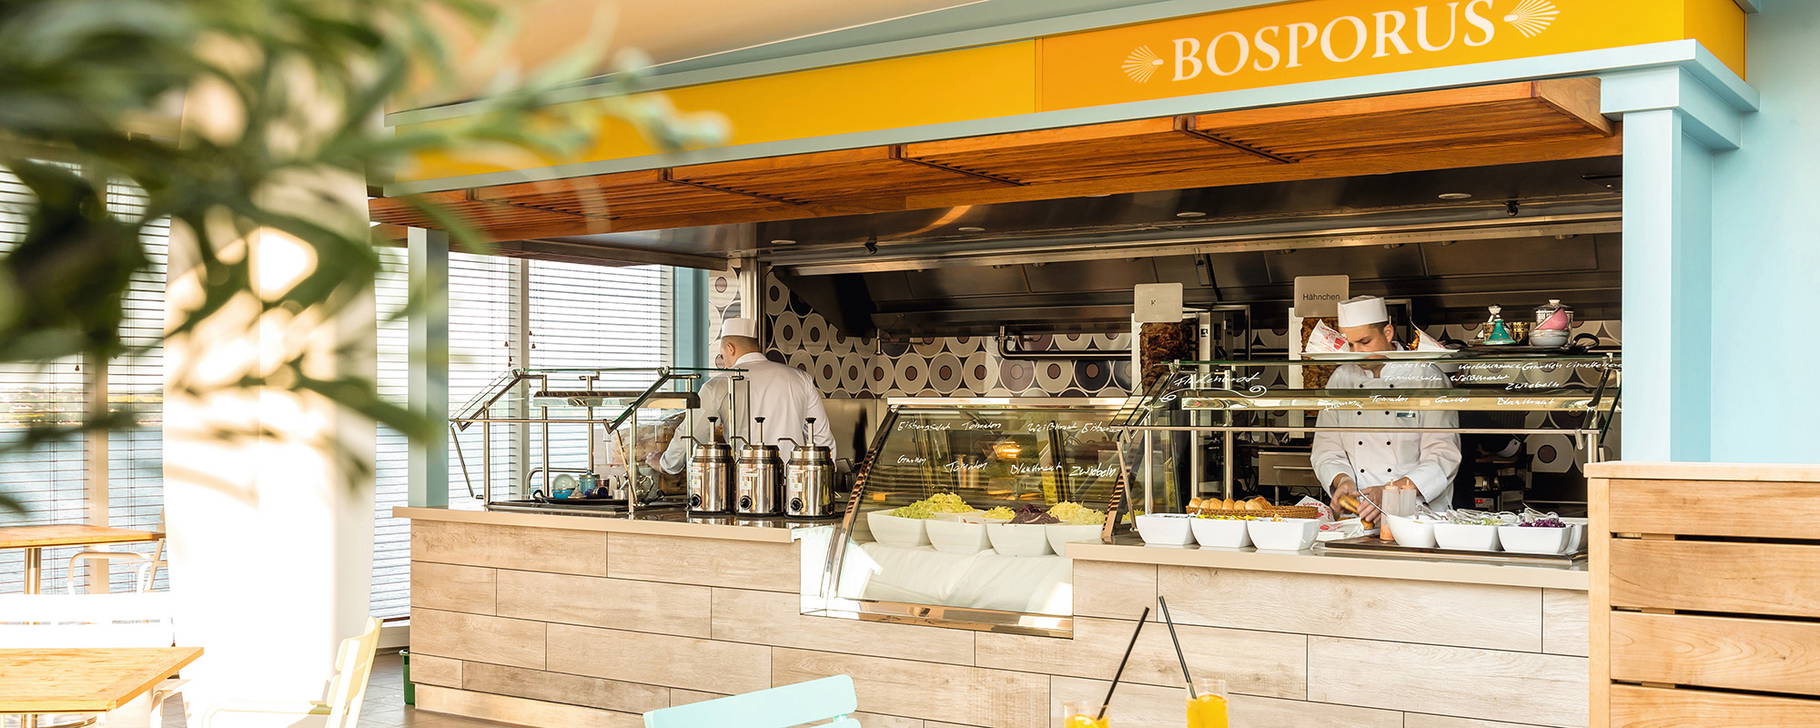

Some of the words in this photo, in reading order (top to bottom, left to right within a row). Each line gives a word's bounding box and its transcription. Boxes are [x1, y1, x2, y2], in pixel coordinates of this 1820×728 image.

[1171, 0, 1496, 83] BOSPORUS
[1302, 292, 1341, 301] Hähnchen
[961, 418, 1002, 431] Tomaten
[944, 460, 988, 473] Tomaten
[1069, 463, 1117, 477] Zwiebeln
